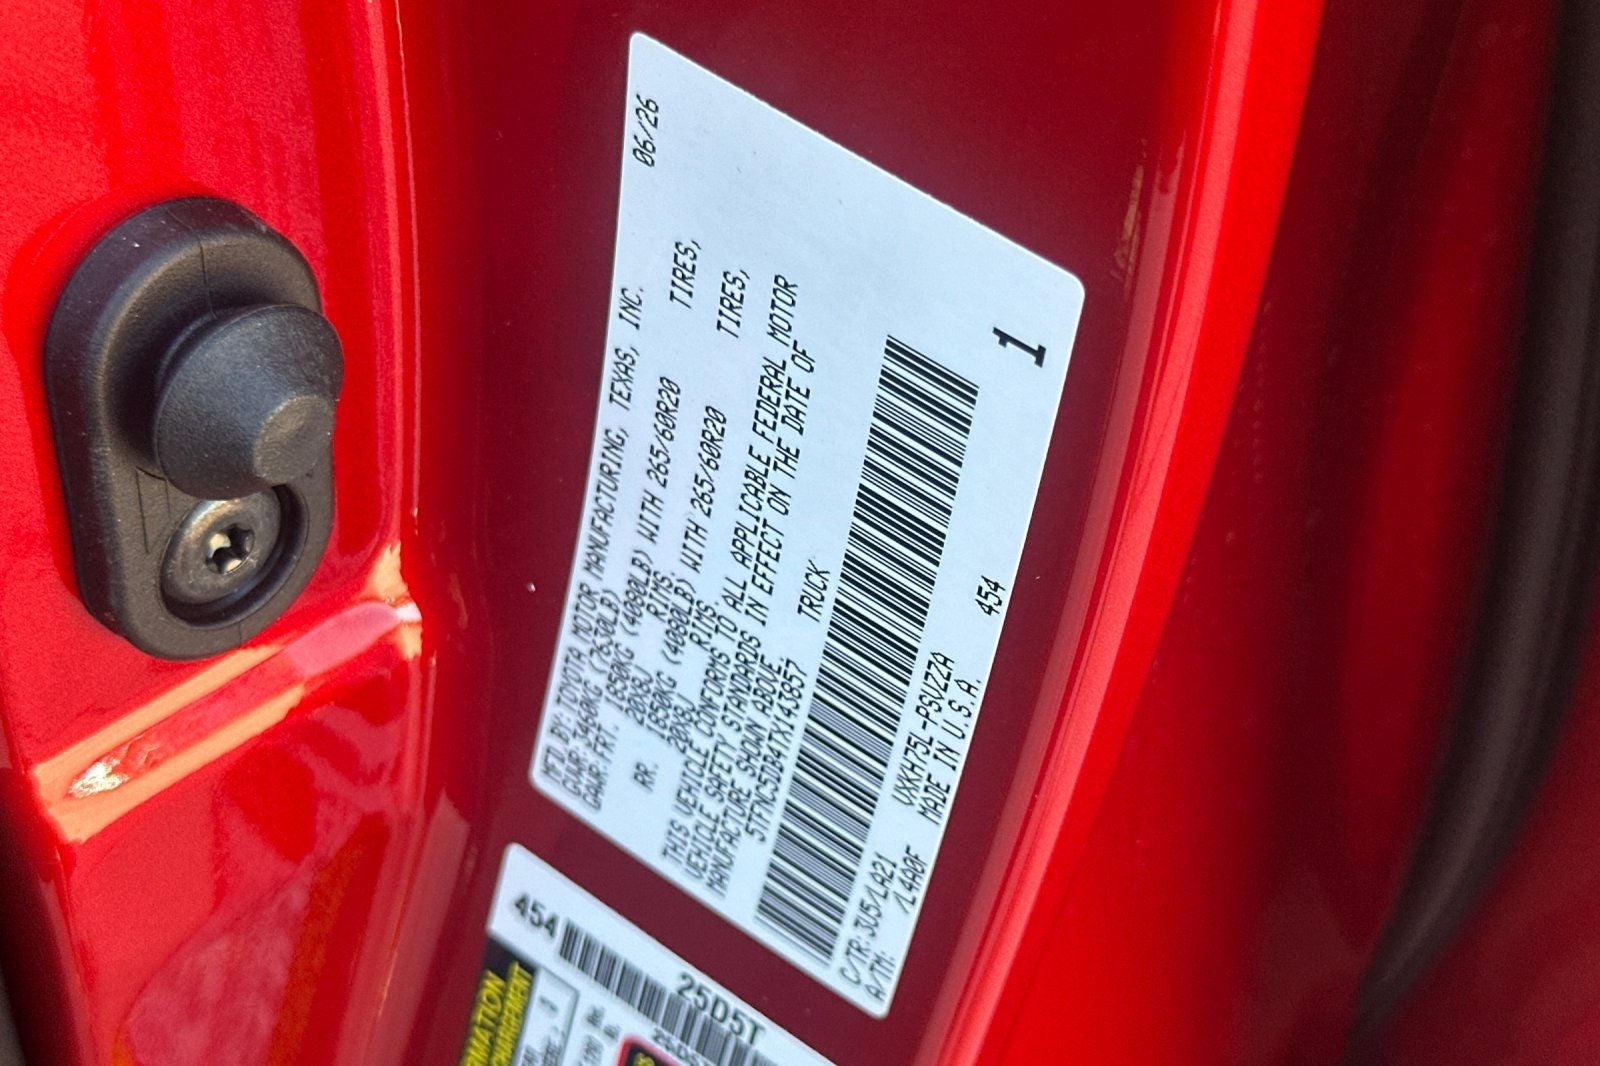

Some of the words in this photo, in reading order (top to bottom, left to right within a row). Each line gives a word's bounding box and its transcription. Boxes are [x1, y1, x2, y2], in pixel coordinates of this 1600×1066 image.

[632, 93, 660, 168] 06/26
[618, 287, 644, 331] INC.
[669, 240, 702, 310] TIRES,
[716, 269, 751, 339] TIRES,
[766, 274, 799, 348] MOTOR
[608, 346, 640, 411] TEXAS,
[790, 339, 816, 374] OF
[992, 326, 1047, 369] 1
[646, 376, 681, 489] 265/60R20
[751, 356, 787, 445] FEDERAL
[780, 376, 811, 437] DATE
[689, 405, 727, 519] 265/60R20
[772, 436, 801, 480] THE
[582, 427, 629, 581] MANUFACTURING,
[636, 488, 665, 545] WITH
[729, 444, 772, 570] APPLICABLE
[766, 482, 792, 516] ON
[679, 517, 709, 574] WITH
[750, 517, 785, 596] EFFECT
[570, 581, 601, 644] MOTOR
[619, 549, 654, 637] (4080LB)
[661, 578, 697, 665] (4080LB)
[721, 576, 748, 614] ALL
[744, 595, 770, 627] IN
[974, 575, 1006, 617] 454
[588, 588, 622, 675] (7630LB)
[624, 664, 655, 728] 20X8J
[645, 570, 676, 624] RIMS.
[713, 614, 739, 643] TO
[604, 641, 636, 713] 1850KG
[645, 670, 678, 741] 1850KG
[665, 692, 697, 756] 20X8J
[688, 599, 719, 653] RIMS.
[692, 646, 732, 739] CONFORMS
[720, 629, 762, 733] STANDARDS
[744, 657, 808, 843] 5TFNC5DB4TX143857
[796, 558, 831, 623] TRUCK
[750, 653, 785, 719] ABOVE.
[940, 678, 981, 740] U.S.A.
[735, 716, 768, 779] SHOWN
[891, 651, 955, 807] VXKH75L-PSVZZA
[932, 740, 961, 772] IN
[633, 761, 659, 792] RR.
[674, 738, 711, 817] VEHICLE
[703, 732, 738, 804] SAFETY
[916, 772, 951, 826] MADE
[661, 818, 691, 865] THIS
[684, 803, 721, 880] VEHICLE
[705, 777, 753, 898] MANUFACTURE
[514, 893, 559, 938] 454
[677, 972, 765, 1044] 25D5T
[863, 951, 896, 1003] A/TM:
